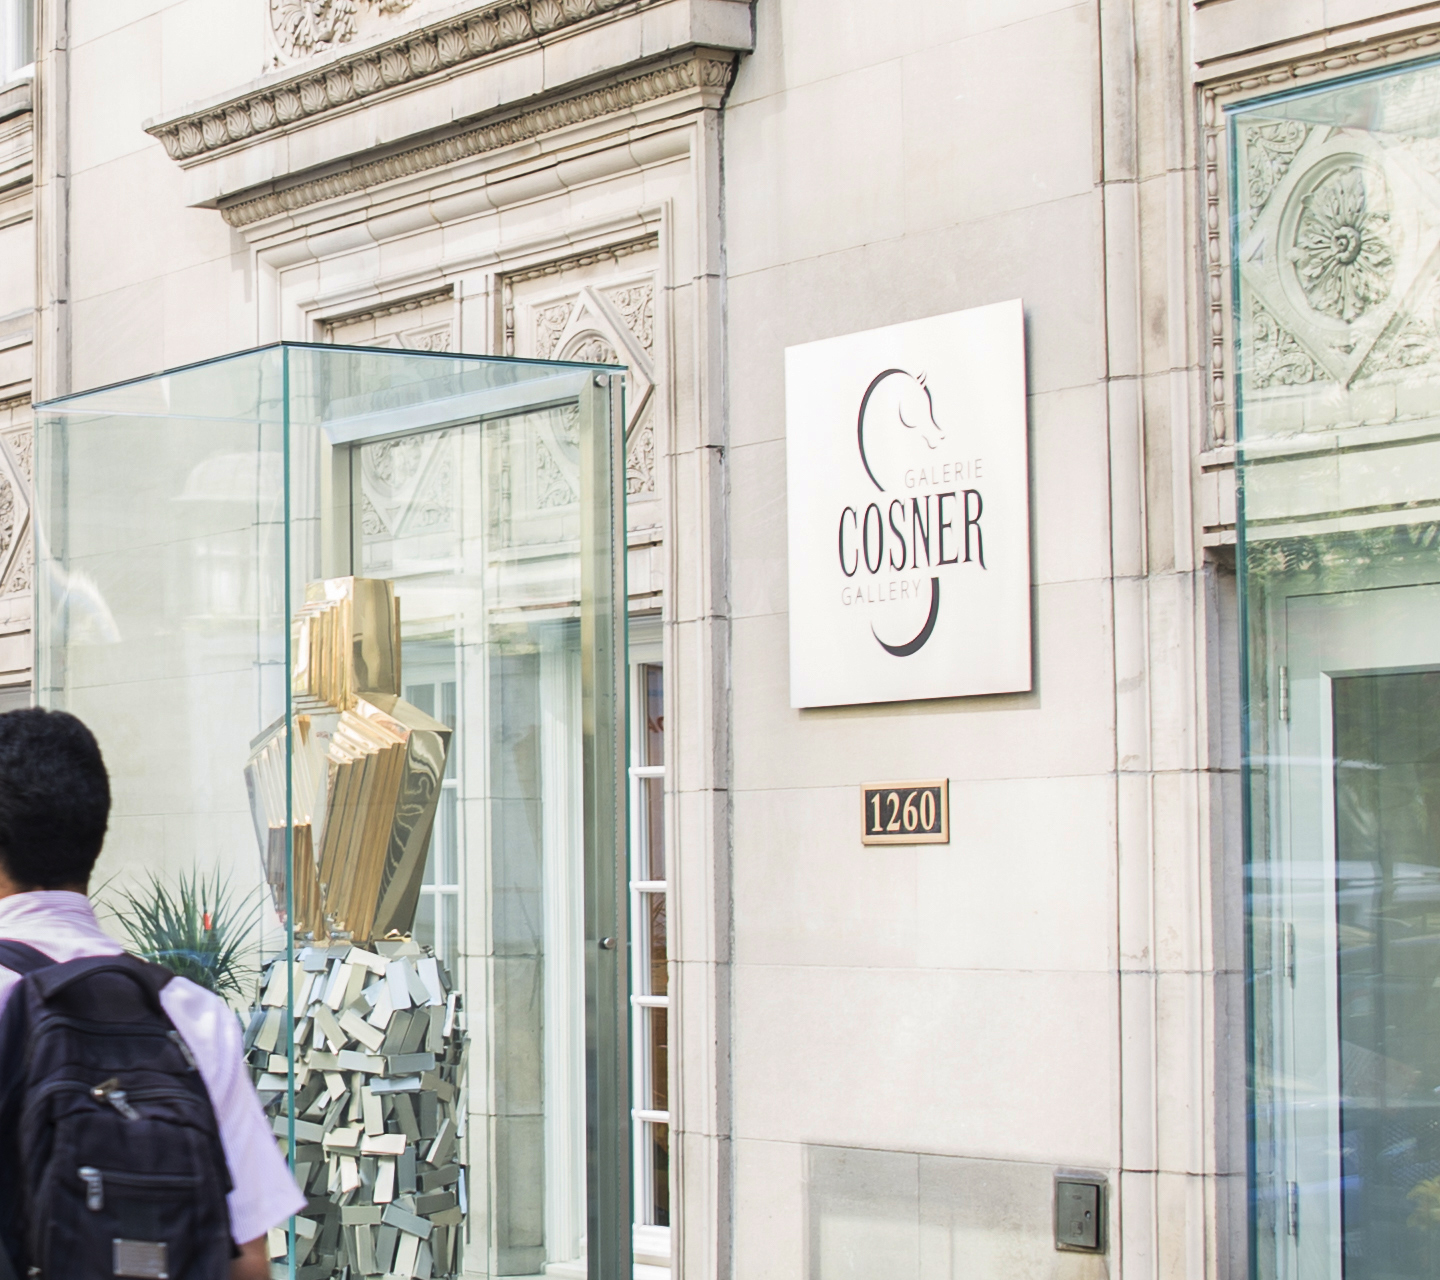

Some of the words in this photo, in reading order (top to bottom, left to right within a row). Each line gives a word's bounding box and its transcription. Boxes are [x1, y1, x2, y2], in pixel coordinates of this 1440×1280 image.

[904, 458, 983, 489] GALERIE
[838, 489, 987, 578] COSNER
[841, 579, 921, 606] GALLERY
[870, 790, 936, 832] 1260
